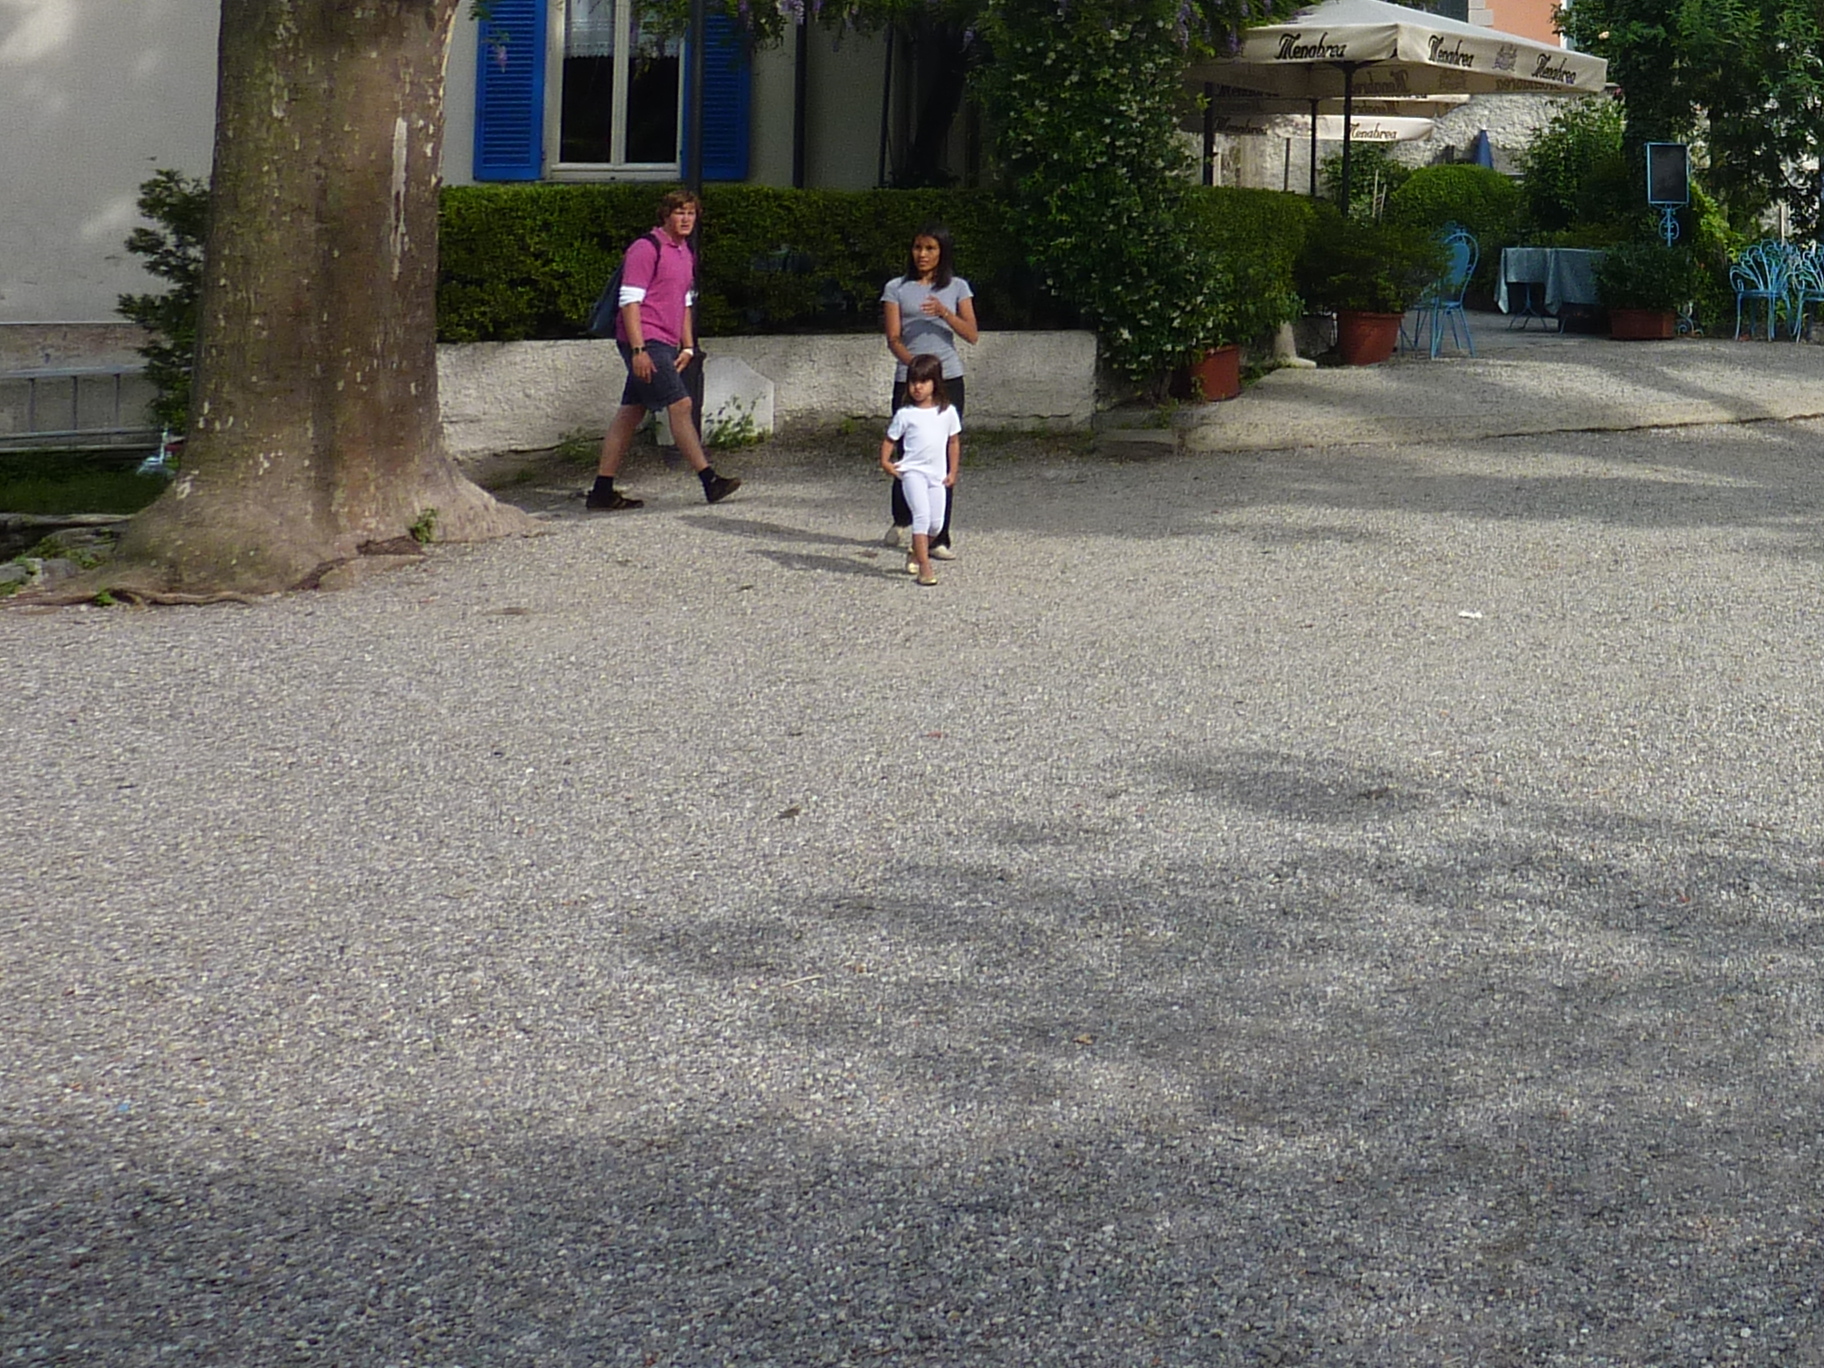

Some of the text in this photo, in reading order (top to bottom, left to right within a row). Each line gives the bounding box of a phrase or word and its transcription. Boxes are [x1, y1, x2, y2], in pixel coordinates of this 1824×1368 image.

[1274, 31, 1347, 60] Menabrea
[1427, 34, 1475, 68] Menabrea
[1531, 53, 1577, 85] Menabrea
